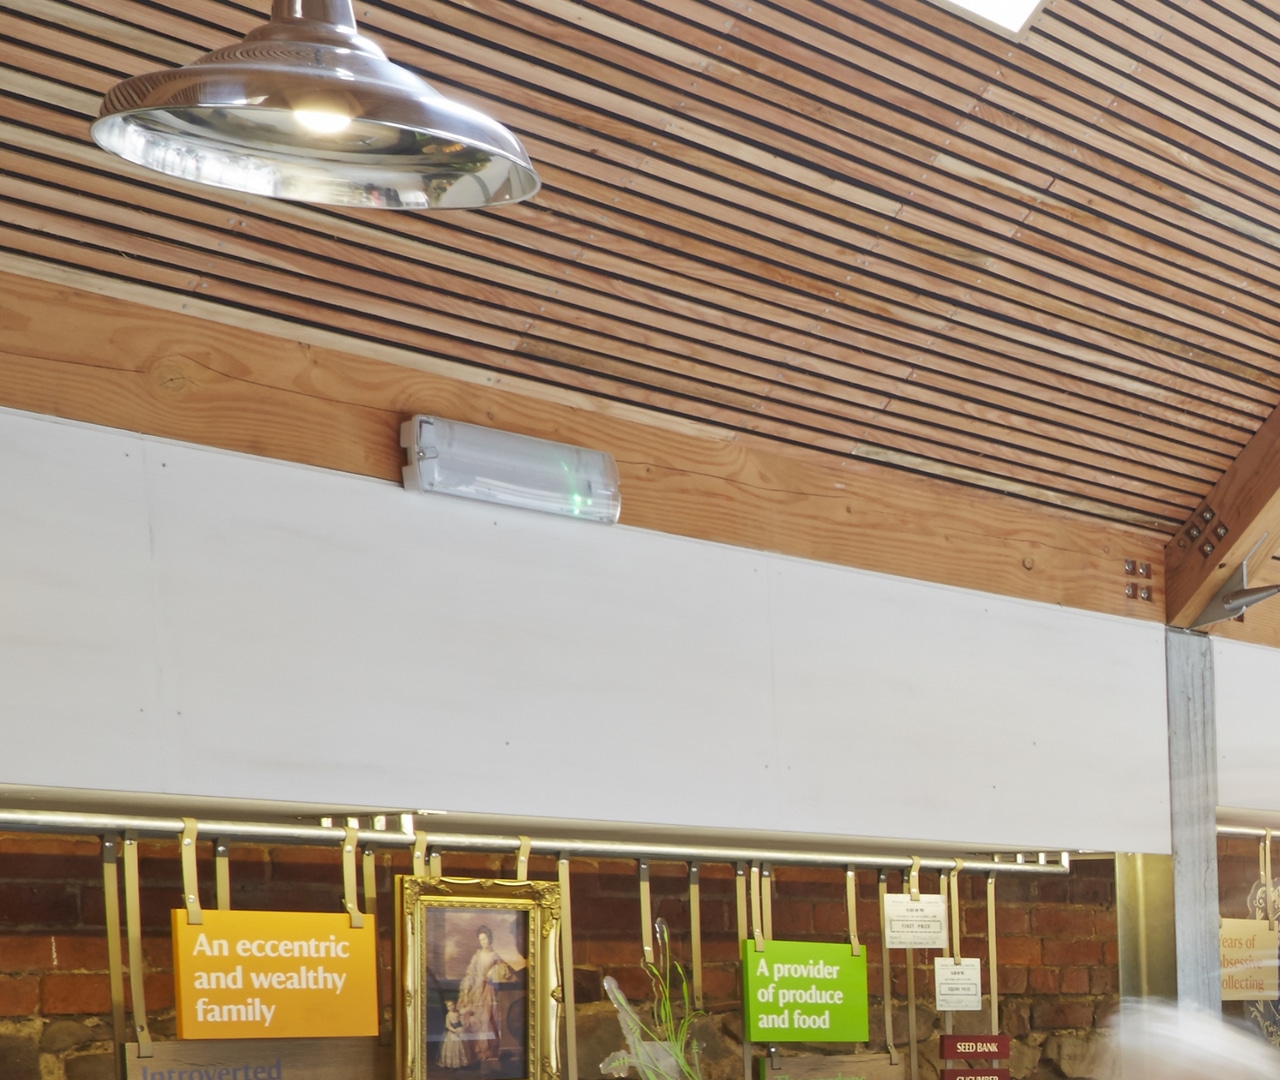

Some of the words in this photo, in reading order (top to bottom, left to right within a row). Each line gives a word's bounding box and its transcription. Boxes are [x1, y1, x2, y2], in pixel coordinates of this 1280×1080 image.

[193, 933, 229, 956] An
[236, 935, 350, 958] eccentric
[1220, 935, 1243, 949] ears
[1245, 935, 1256, 949] of
[194, 966, 243, 989] and
[250, 966, 346, 995] wealthy
[757, 958, 769, 976] A
[773, 960, 839, 981] provider
[1221, 975, 1264, 992] ollecting
[757, 984, 776, 1002] of
[778, 985, 844, 1007] produce
[195, 998, 276, 1027] family
[758, 1010, 789, 1028] and
[793, 1009, 830, 1029] food
[956, 1042, 976, 1053] SEED
[977, 1042, 998, 1053] BANK
